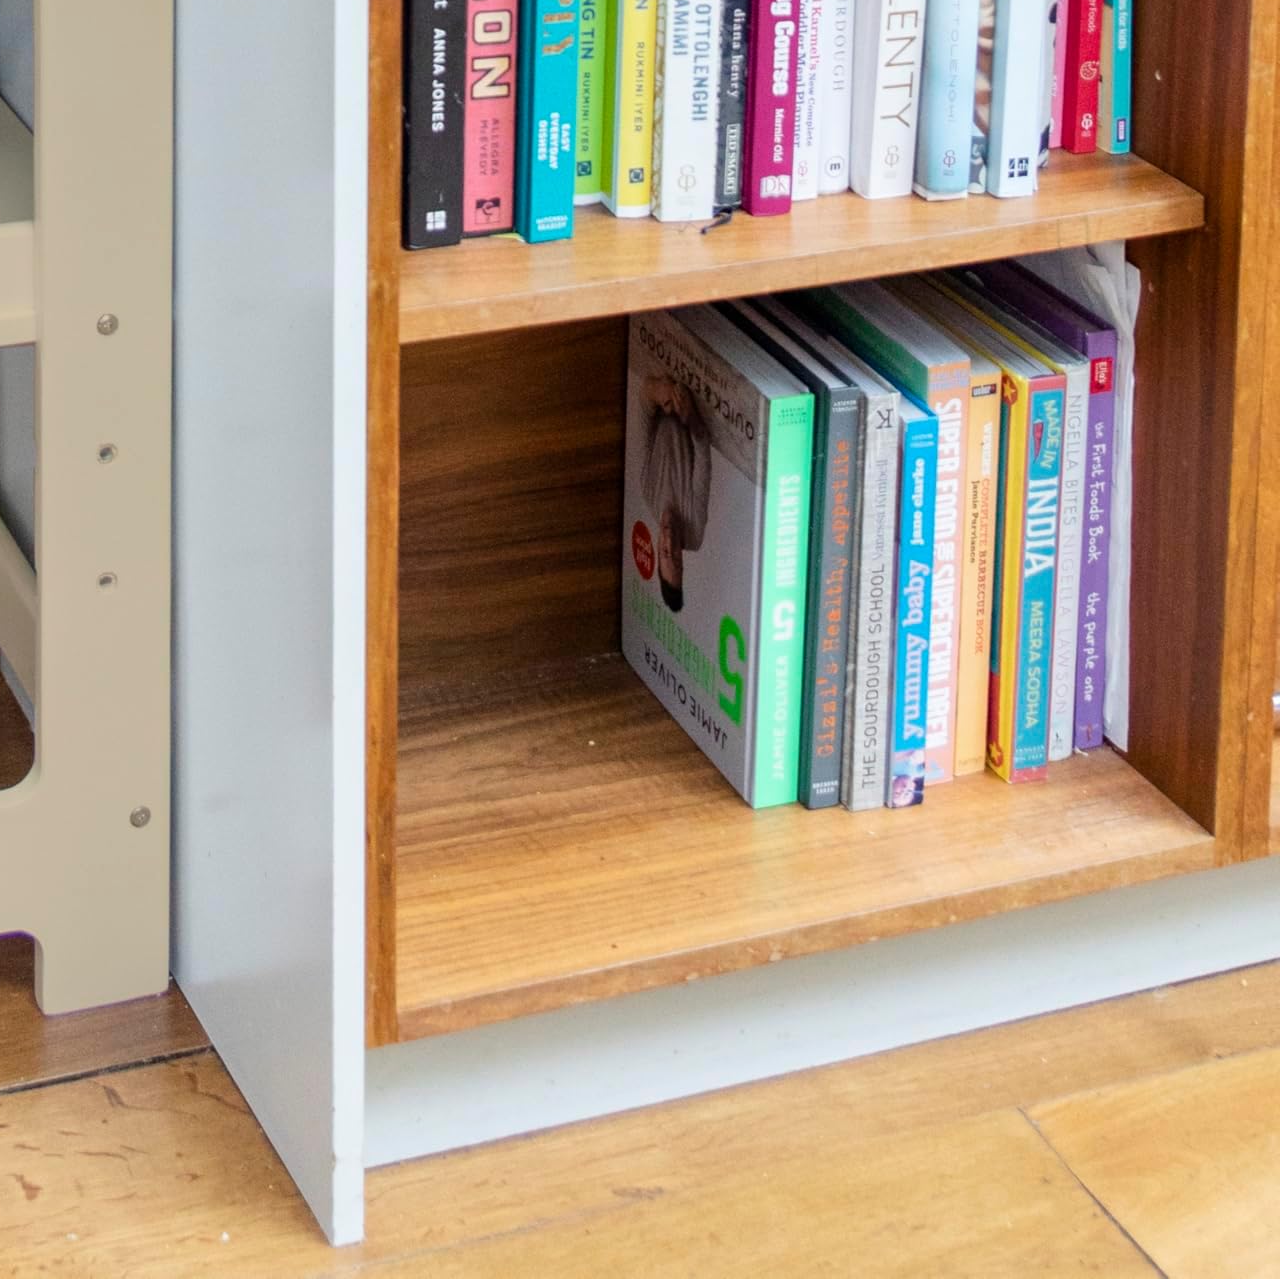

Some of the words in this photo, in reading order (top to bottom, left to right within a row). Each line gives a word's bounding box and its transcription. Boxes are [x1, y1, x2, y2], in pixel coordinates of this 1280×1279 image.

[731, 7, 747, 51] diana
[808, 5, 822, 71] Karmel's
[1087, 8, 1097, 32] Foods
[1118, 12, 1128, 27] for
[432, 27, 447, 75] ANNA
[581, 29, 595, 60] TIN
[691, 4, 712, 122] OTTOLENGHI
[771, 20, 796, 97] Course
[634, 42, 646, 97] RUKMINI
[726, 54, 744, 99] henry
[807, 73, 816, 96] New
[431, 79, 446, 133] JONES
[581, 71, 592, 122] RUKMINI
[633, 102, 643, 133] IYER
[537, 119, 548, 161] DISHES
[549, 112, 561, 169] EVERYDAY
[561, 123, 570, 152] EASY
[580, 125, 590, 153] IYER
[774, 108, 785, 143] Marnie
[805, 97, 815, 146] Complete
[490, 118, 500, 176] ALLEGRA
[773, 143, 784, 163] Old
[763, 175, 790, 195] DK
[639, 326, 672, 367] FOOD
[674, 358, 702, 395] EASY
[714, 392, 754, 441] QUICK
[935, 397, 962, 472] SUPER
[1042, 399, 1060, 448] MADE
[1066, 394, 1082, 472] NIGELLA
[1094, 421, 1105, 439] the
[875, 458, 889, 508] Kimbell
[912, 458, 925, 508] clarke
[1039, 449, 1058, 469] IN
[1091, 444, 1107, 477] First
[934, 478, 958, 538] FOOD
[971, 479, 980, 508] Jamie
[979, 478, 991, 546] COMPLETE
[1063, 479, 1079, 525] BITES
[1088, 480, 1104, 521] Foods
[776, 474, 801, 587] INGREDIENTS
[873, 511, 887, 560] Vanessa
[910, 511, 925, 546] jane
[970, 510, 979, 564] Purviance
[1024, 476, 1058, 578] INDIA
[1087, 525, 1104, 564] Book
[869, 564, 885, 633] SCHOOL
[902, 559, 930, 627] baby
[976, 550, 988, 616] BARBECUE
[1059, 534, 1076, 617] NIGELLA
[773, 600, 796, 641] 5
[822, 557, 848, 653] Healthy
[1086, 592, 1100, 616] the
[974, 619, 985, 655] BOOK
[1028, 600, 1044, 662] MEERA
[1083, 621, 1099, 670] purple
[643, 641, 687, 705] OLIVER
[717, 613, 747, 727] 5
[774, 655, 788, 722] OLIVER
[864, 640, 881, 748] SOURDOUGH
[902, 633, 928, 740] yummy
[1054, 628, 1070, 715] LAWSON
[1084, 676, 1095, 702] one
[816, 661, 838, 757] Gizzi's
[1025, 665, 1040, 729] SODHA
[689, 695, 728, 749] JAMIE
[772, 727, 786, 780] JAMIE
[861, 753, 877, 788] THE
